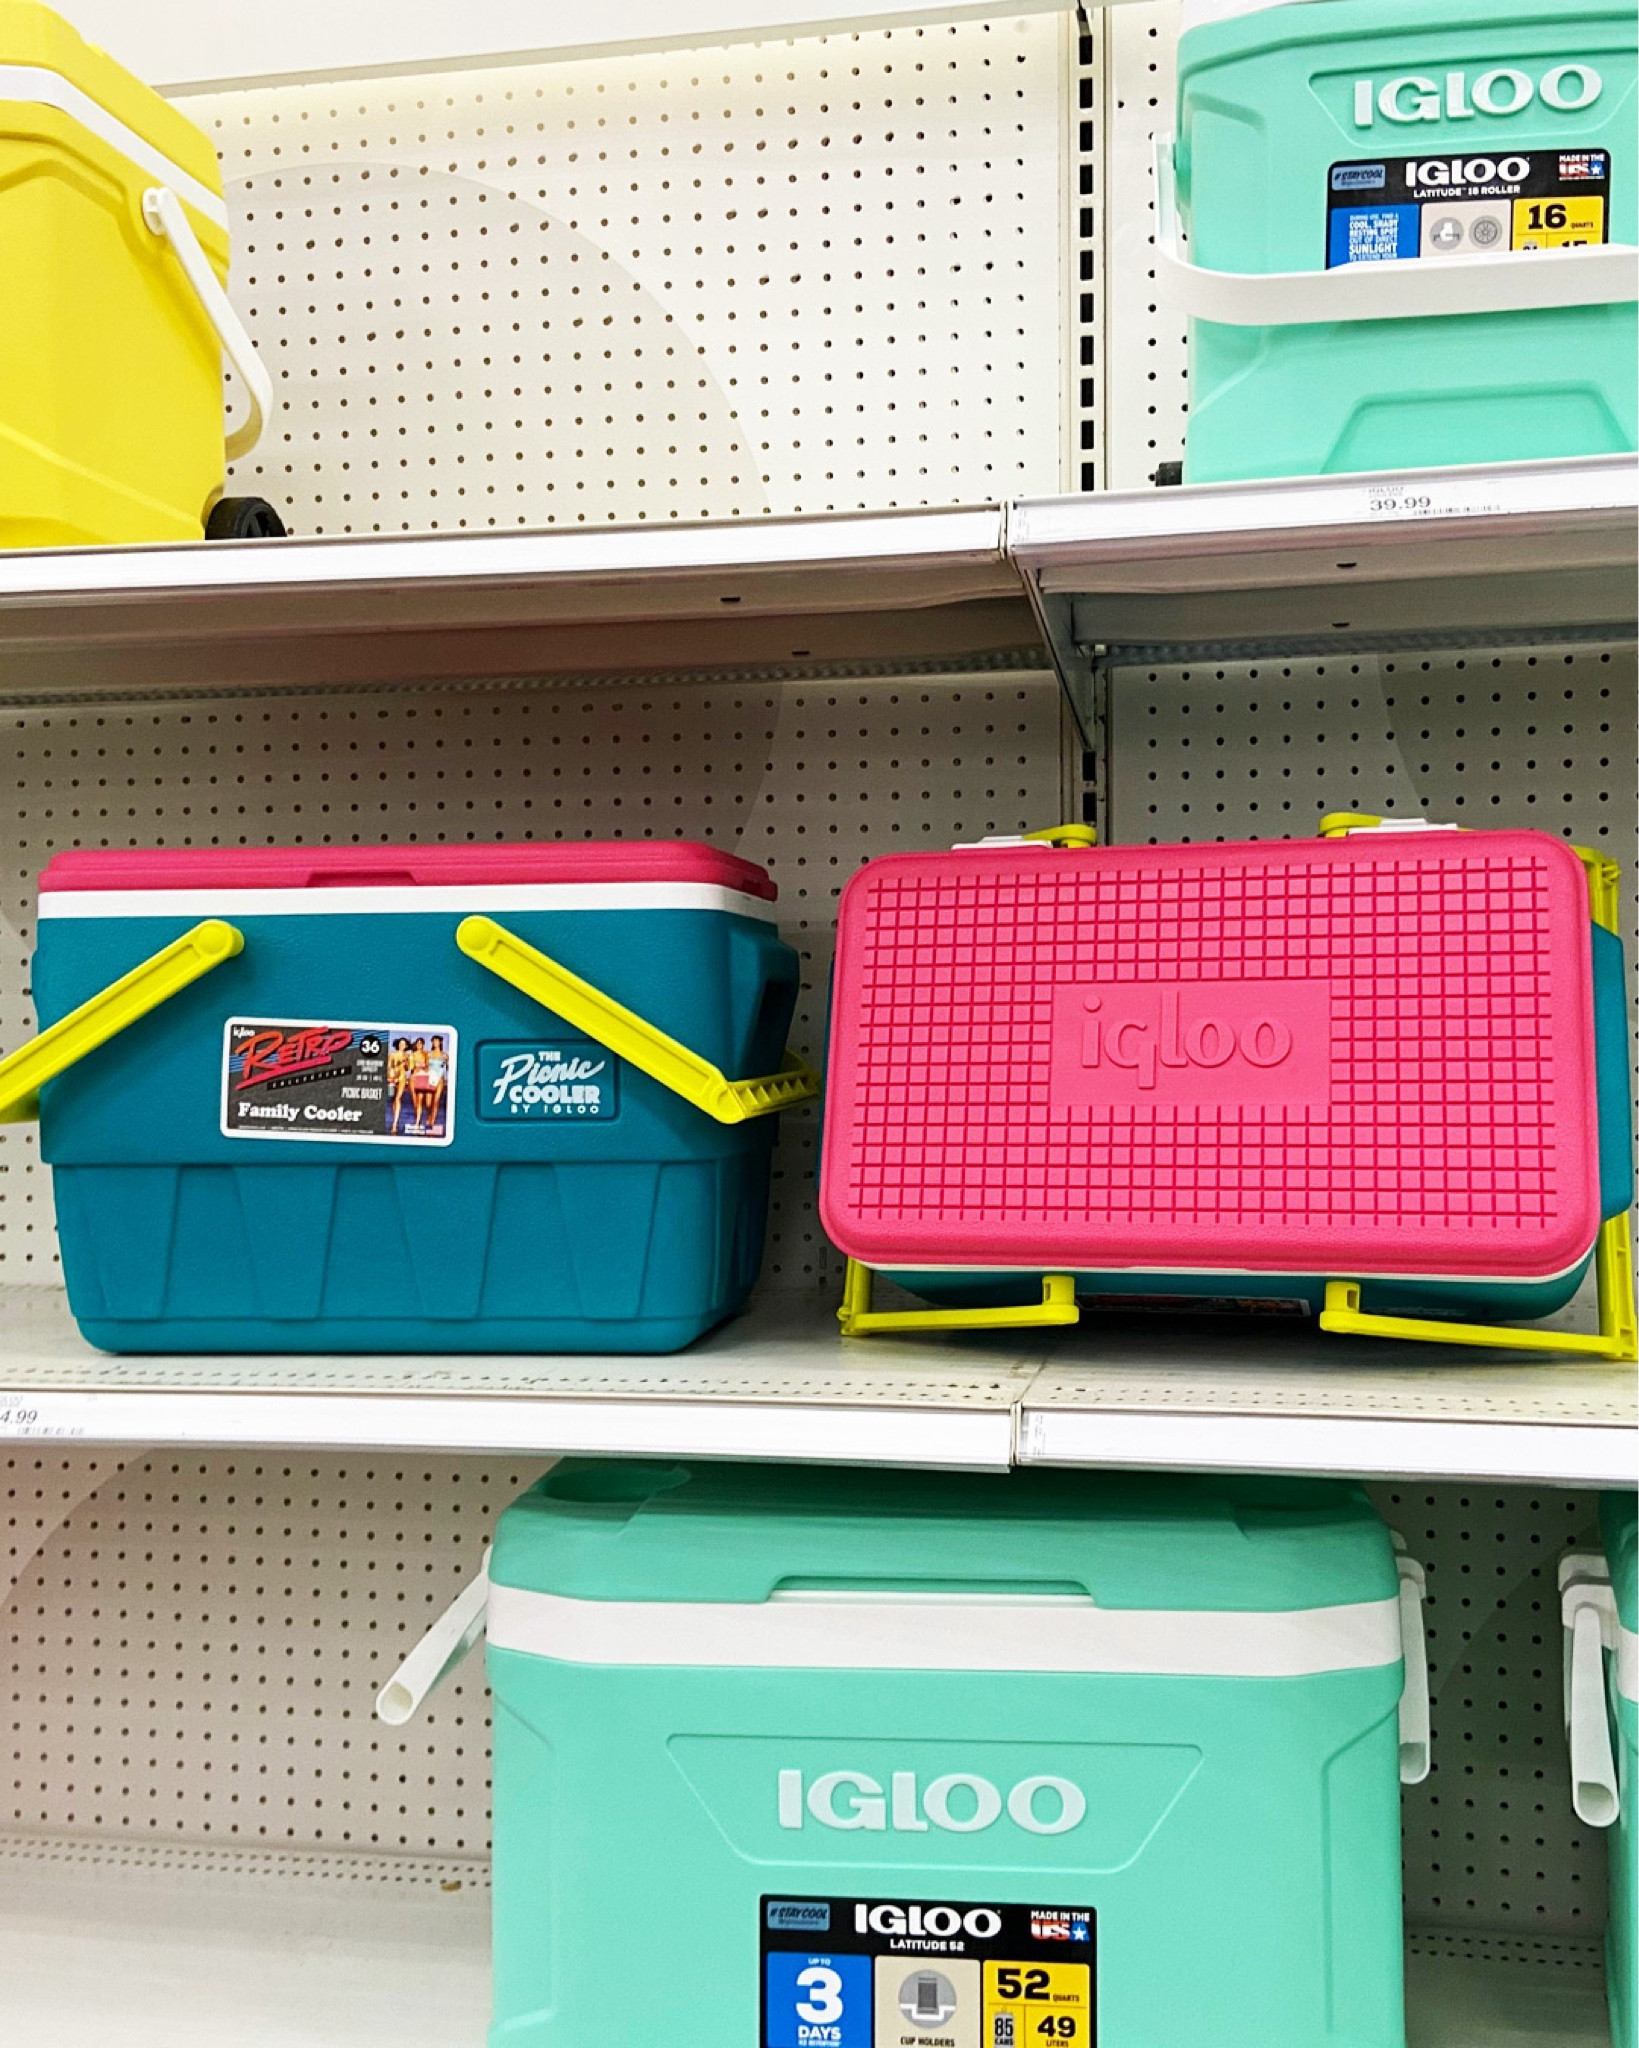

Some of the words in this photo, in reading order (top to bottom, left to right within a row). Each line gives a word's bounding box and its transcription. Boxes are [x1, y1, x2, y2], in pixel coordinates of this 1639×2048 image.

[1354, 64, 1602, 127] IGLOO
[1591, 153, 1605, 161] THE
[1406, 157, 1530, 187] IGLOO
[1559, 161, 1604, 177] USA
[1413, 188, 1461, 198] LATITUDE
[1481, 185, 1520, 195] ROLLER
[1528, 203, 1566, 229] 16
[1349, 242, 1398, 255] SUNLIGHT
[1370, 496, 1431, 511] 39.99
[361, 1040, 380, 1053] 36
[1082, 991, 1292, 1089] igloo
[538, 1051, 560, 1062] THE
[492, 1053, 606, 1104] Picnic
[509, 1084, 600, 1104] COOLER
[238, 1102, 300, 1121] Family
[304, 1105, 363, 1121] Cooler
[511, 1104, 530, 1114] BY
[544, 1104, 600, 1114] IGLOO
[778, 1769, 1087, 1834] IGLOO
[855, 1904, 1002, 1938] IGLOO
[1031, 1910, 1058, 1920] MADE
[1060, 1912, 1071, 1921] IN
[1072, 1913, 1090, 1923] THE
[1031, 1920, 1090, 1942] USA
[890, 1938, 947, 1951] LATITUDE
[949, 1942, 965, 1952] 52
[821, 1958, 831, 1966] TO
[997, 1968, 1051, 2001] 52
[796, 1965, 844, 2024] 3
[1053, 1995, 1080, 2003] QUARTS
[798, 2025, 842, 2041] DAYS
[994, 2018, 1013, 2037] 85
[1037, 2016, 1076, 2038] 49
[900, 2036, 916, 2046] CUP
[918, 2037, 955, 2048] HOLDERS
[994, 2037, 1014, 2046] CANS
[1046, 2039, 1069, 2048] LITERS
